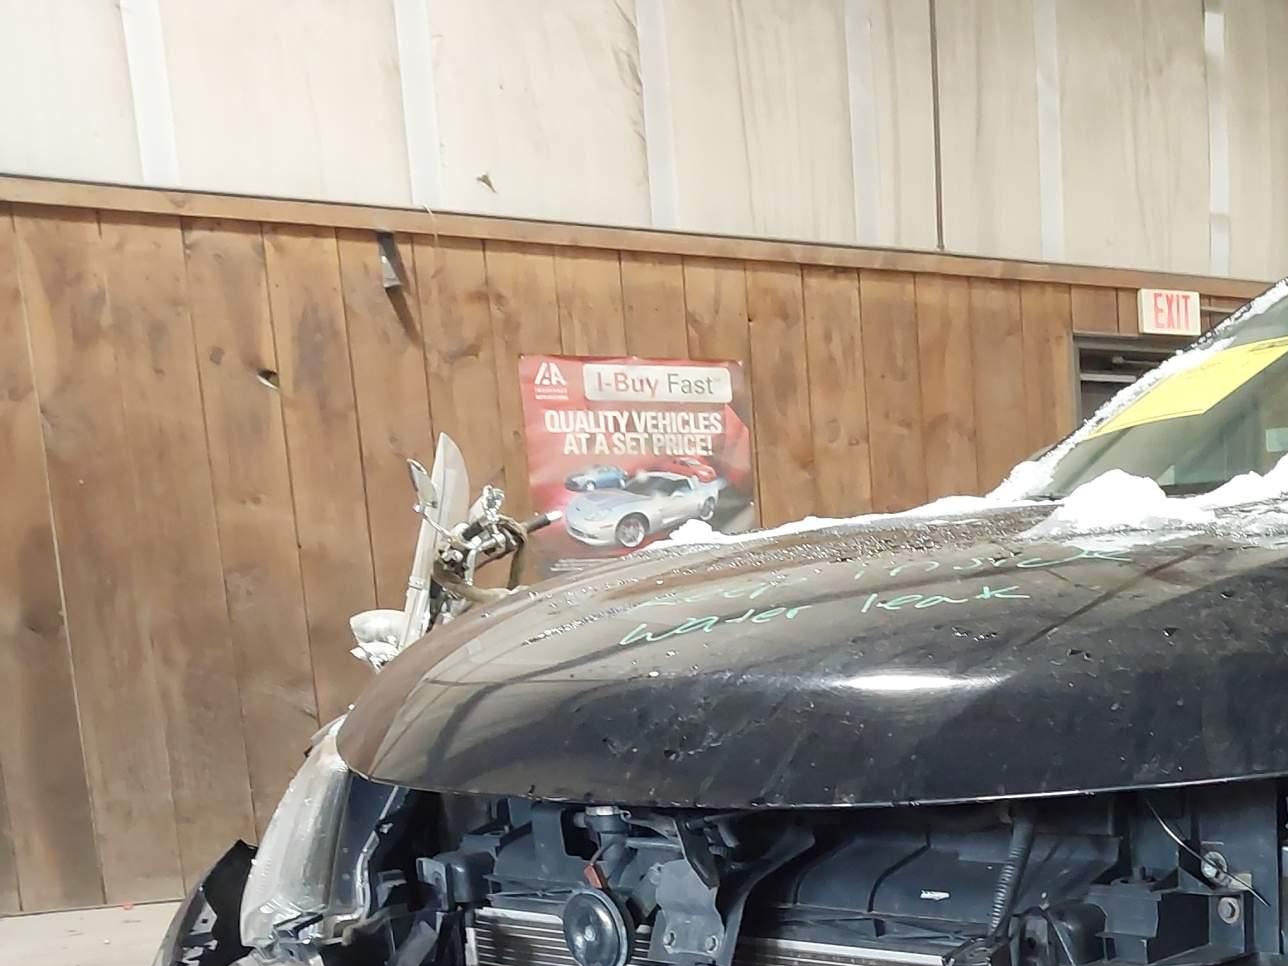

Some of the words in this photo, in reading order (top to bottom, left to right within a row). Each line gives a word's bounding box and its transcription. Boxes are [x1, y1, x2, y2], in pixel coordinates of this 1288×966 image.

[1153, 292, 1190, 329] EXIT
[596, 372, 658, 398] I-Buy
[666, 373, 713, 394] Fast
[544, 410, 629, 433] QUALITY
[631, 411, 723, 433] VEHICLES
[563, 432, 590, 455] AT
[594, 432, 610, 455] A
[612, 432, 648, 455] SET
[651, 434, 713, 456] PRICE!
[861, 586, 1031, 613] leak
